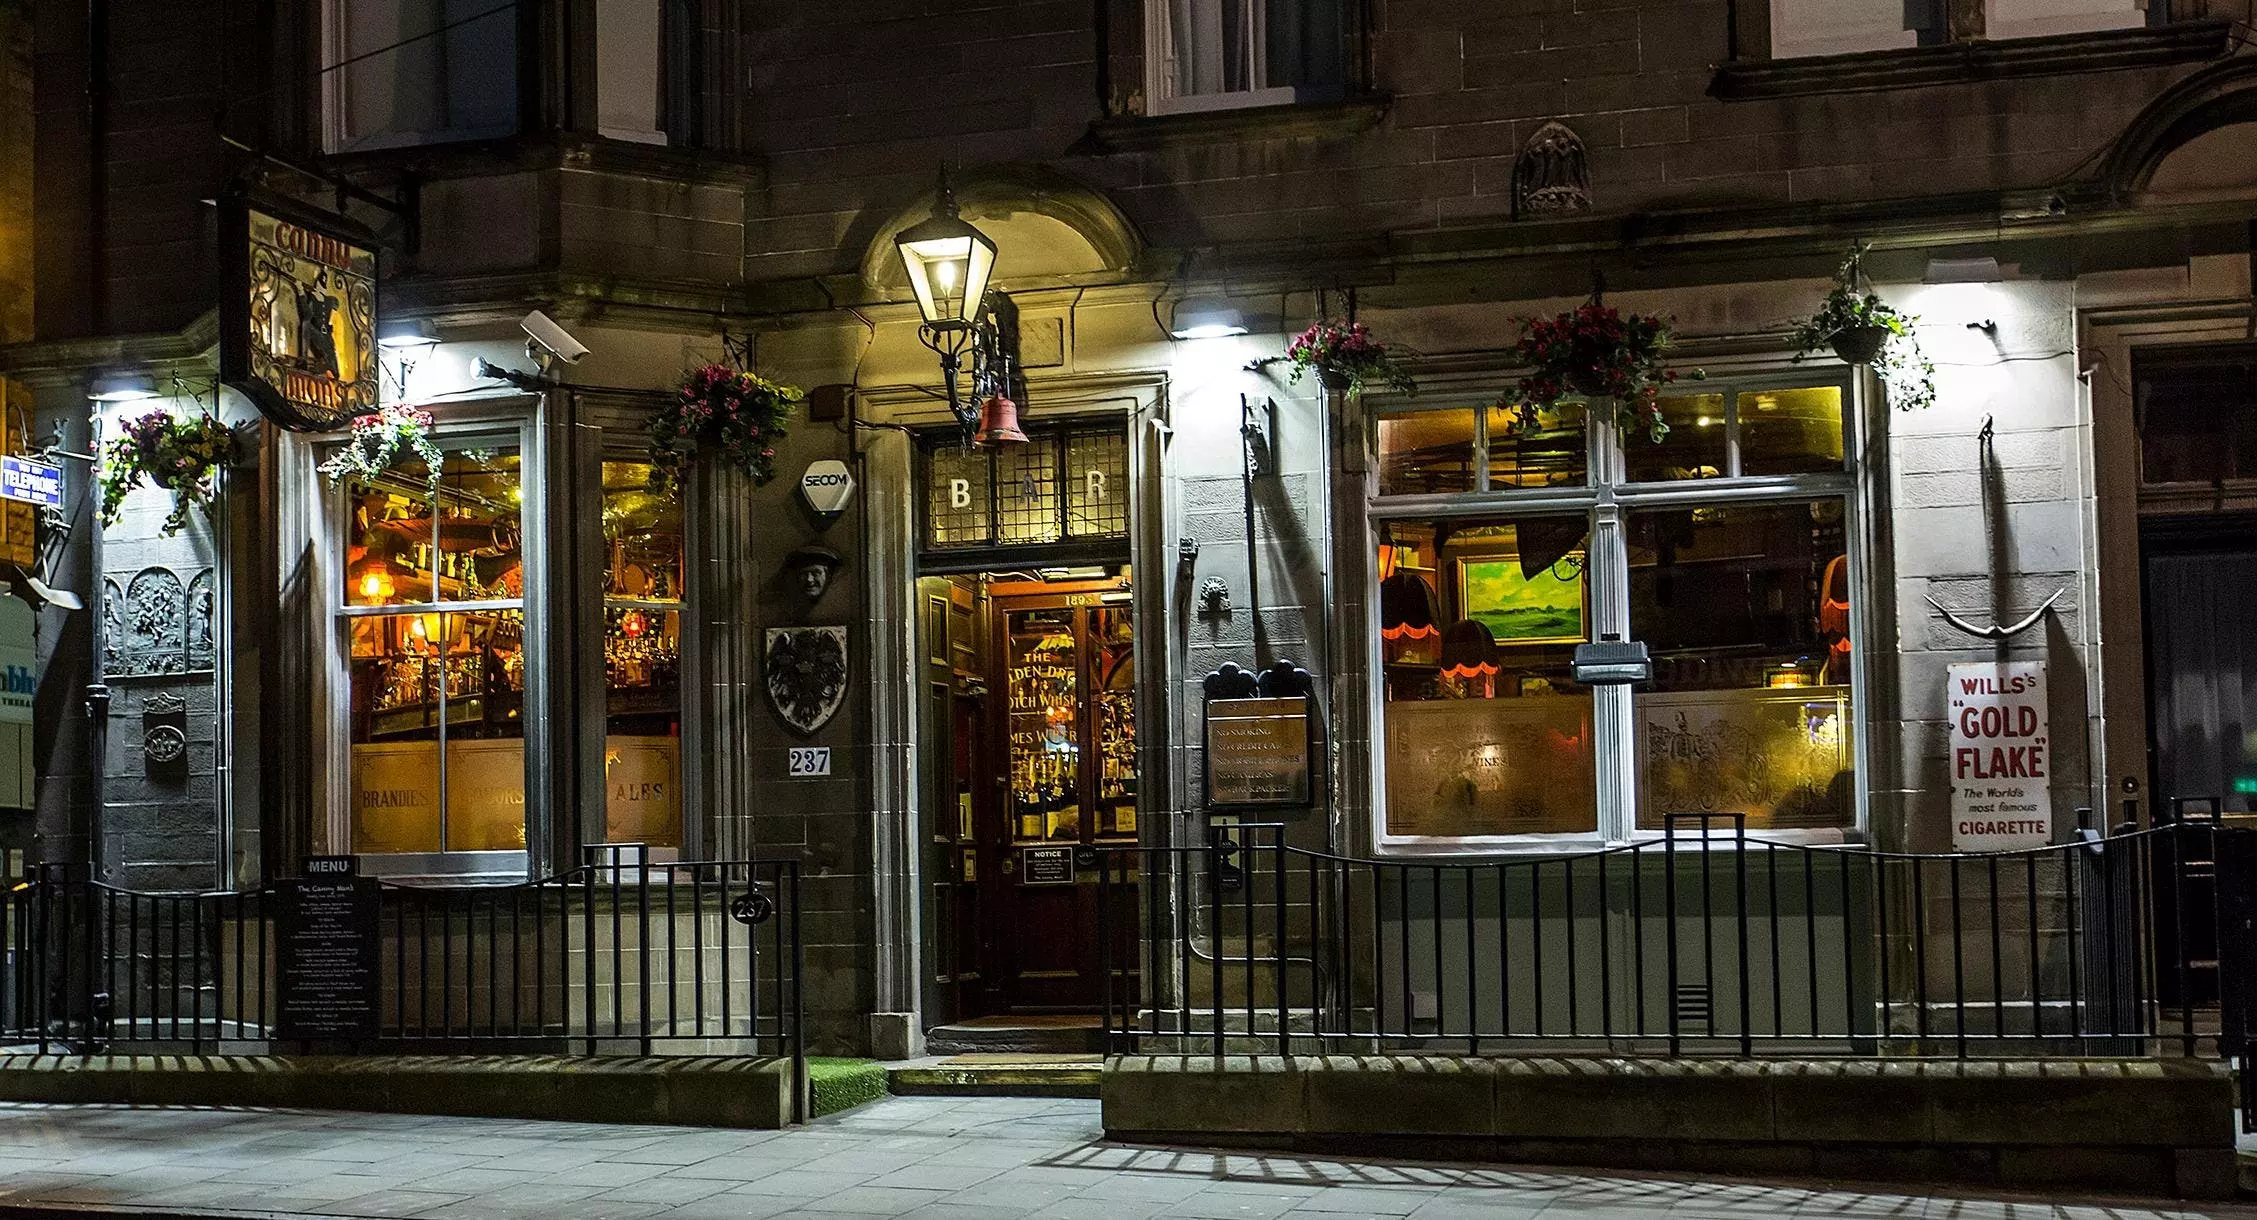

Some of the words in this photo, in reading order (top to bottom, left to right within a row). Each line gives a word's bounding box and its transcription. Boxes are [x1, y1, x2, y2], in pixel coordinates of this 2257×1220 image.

[805, 474, 847, 487] SECOM
[1024, 653, 1051, 663] THE
[790, 750, 829, 774] 237
[362, 789, 429, 808] BRANDIES
[615, 783, 664, 801] ALES
[1963, 788, 1983, 799] The
[1968, 803, 1994, 812] most
[1999, 802, 2038, 812] famous
[1958, 819, 2046, 835] CIGARETTE
[1034, 850, 1062, 858] NOTICE
[309, 860, 348, 873] MENU
[736, 899, 765, 918] 237
